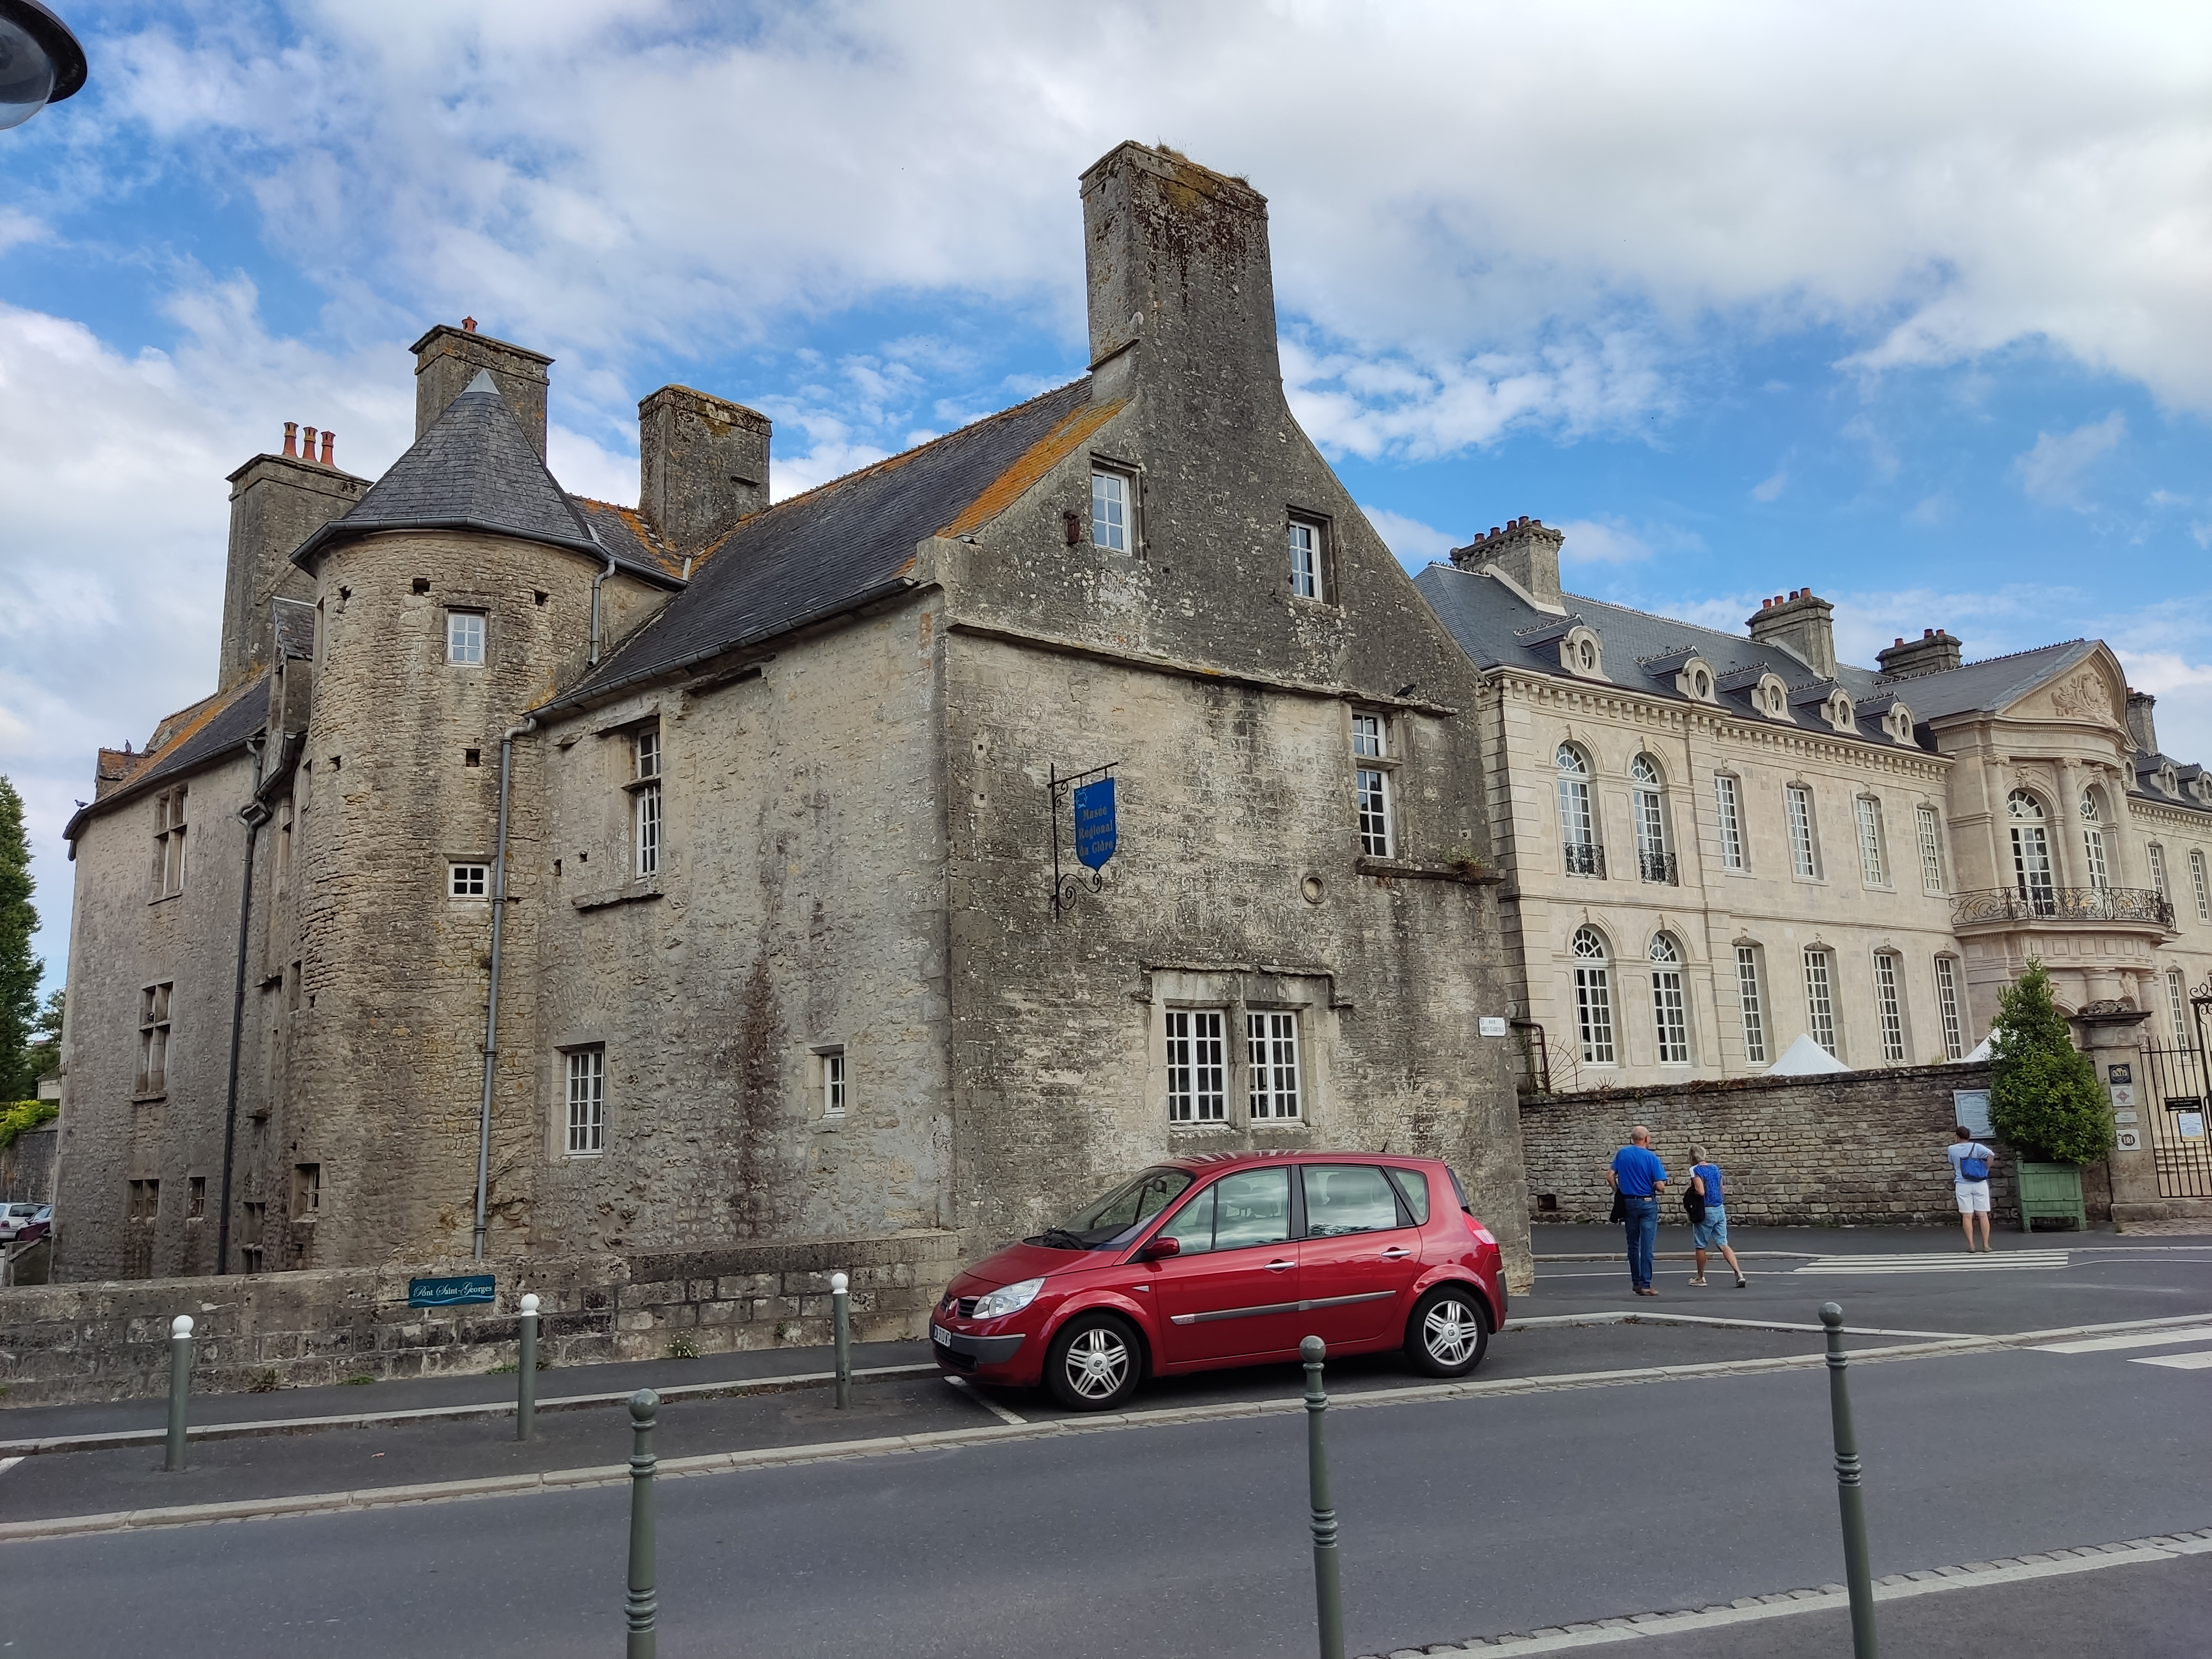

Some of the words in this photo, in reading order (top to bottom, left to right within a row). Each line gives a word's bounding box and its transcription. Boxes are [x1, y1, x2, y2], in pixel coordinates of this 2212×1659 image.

[1082, 805, 1107, 821] Musée
[1078, 820, 1113, 839] Régional
[1079, 846, 1089, 857] du
[413, 1285, 434, 1297] Pont
[436, 1281, 492, 1297] Saint-Georges
